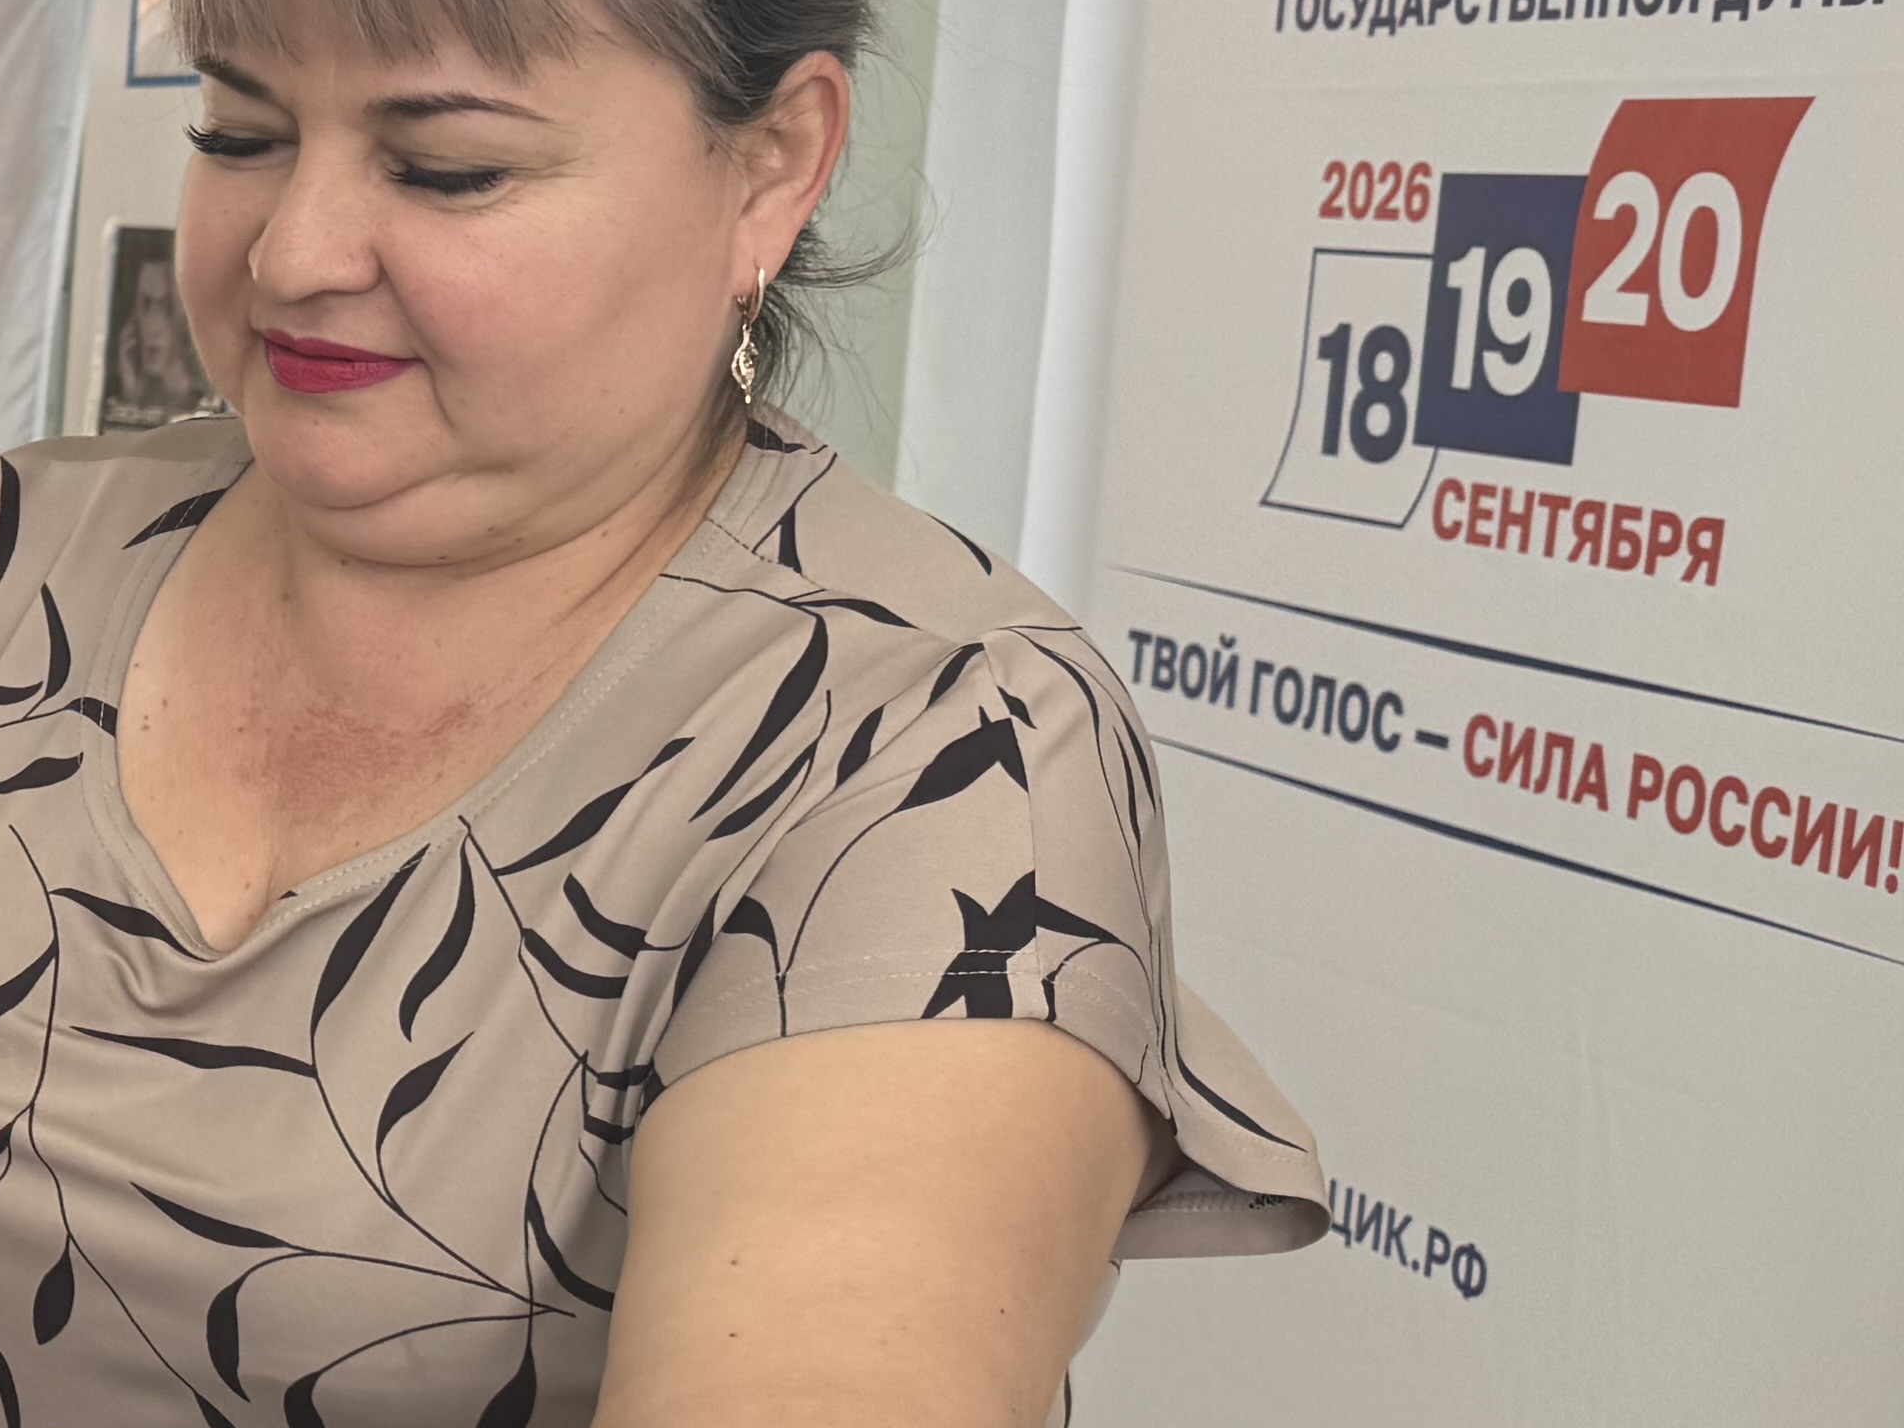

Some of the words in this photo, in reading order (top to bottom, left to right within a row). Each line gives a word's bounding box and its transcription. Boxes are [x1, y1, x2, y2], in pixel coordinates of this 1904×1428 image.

[1319, 160, 1432, 223] 2026
[1317, 322, 1412, 465] 18
[1446, 245, 1552, 396] 19
[1581, 170, 1742, 332] 20
[1432, 479, 1726, 587] СЕНТЯБРЯ
[1127, 628, 1238, 709] ТВОЙ
[1248, 660, 1404, 752] ГОЛОС
[1463, 714, 1609, 812] СИЛА
[1627, 753, 1904, 894] РОССИИ!
[1328, 1178, 1488, 1300] ЦИК.РФ
